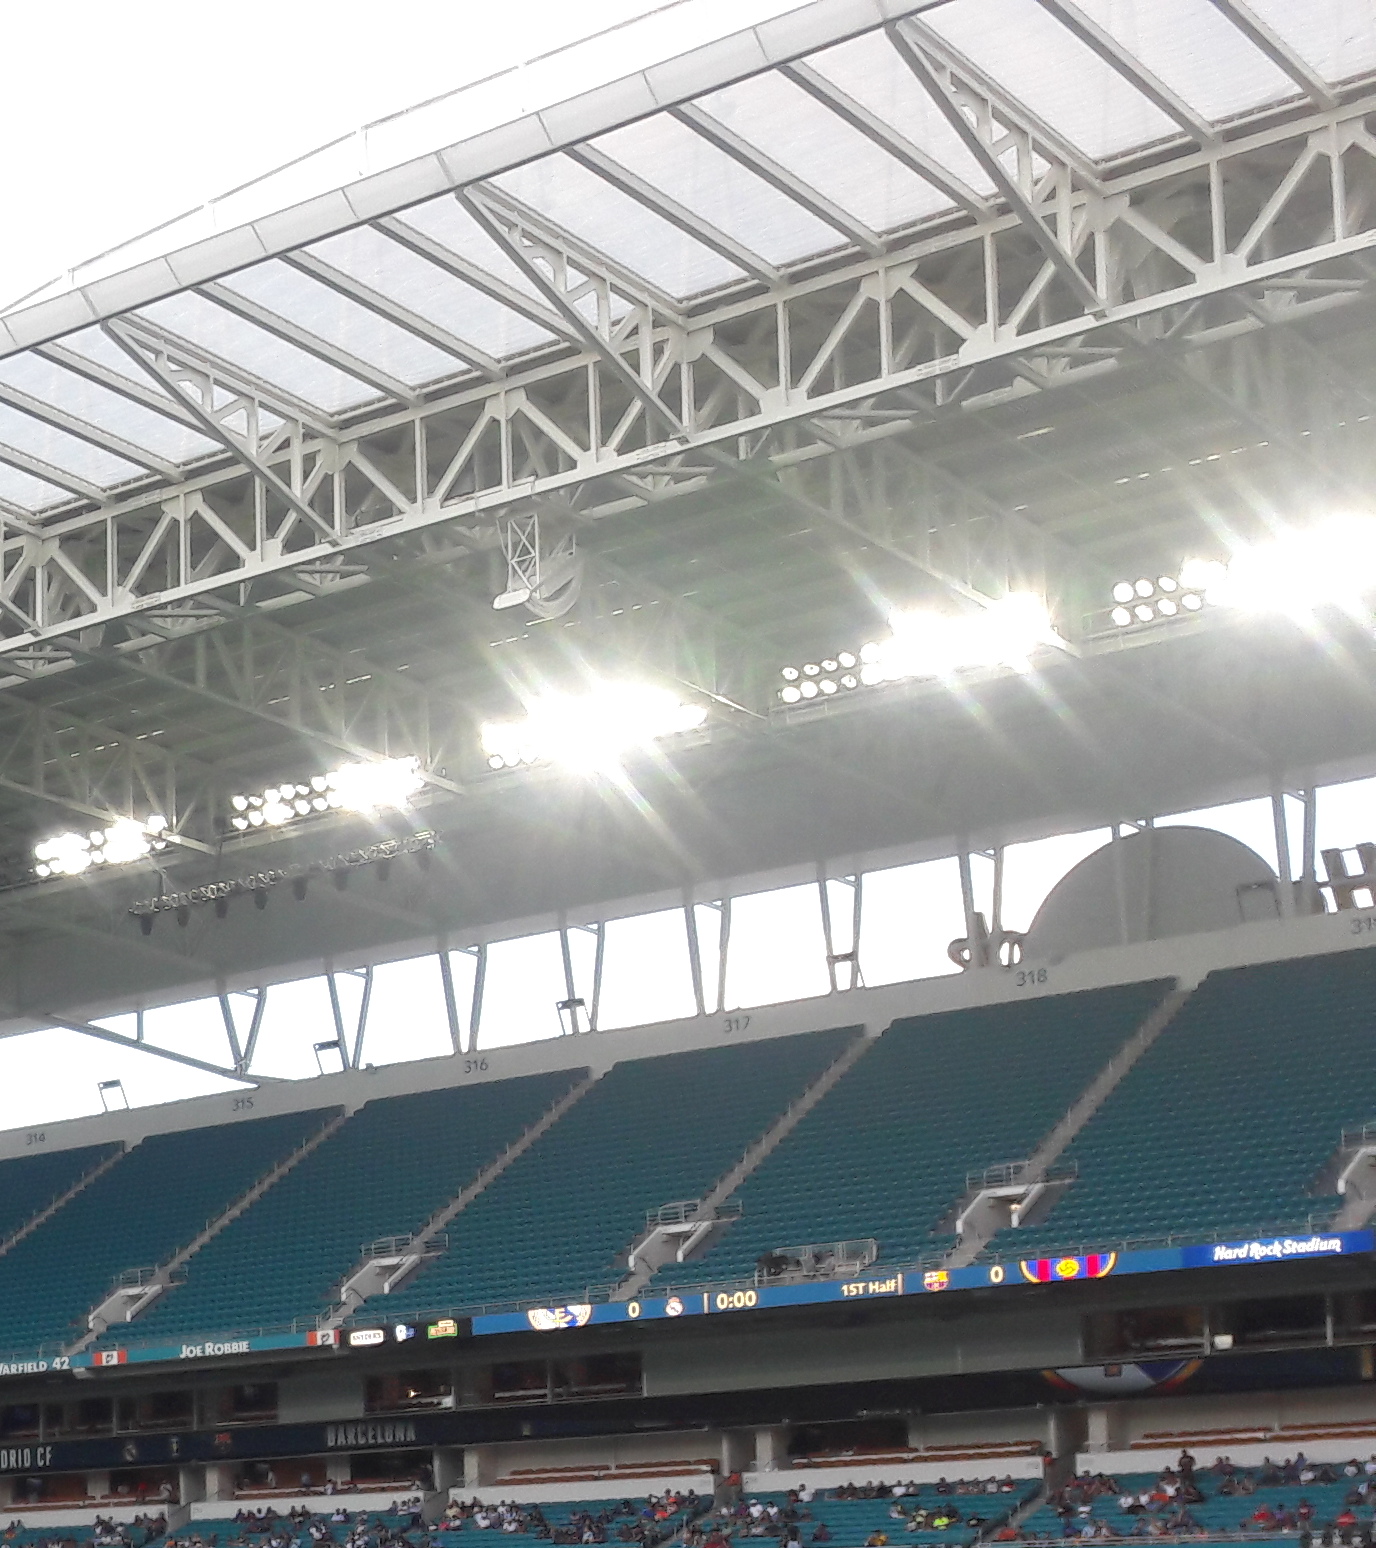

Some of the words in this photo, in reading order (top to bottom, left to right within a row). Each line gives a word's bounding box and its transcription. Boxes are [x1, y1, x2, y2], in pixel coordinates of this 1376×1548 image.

[1015, 969, 1048, 986] 318
[724, 1016, 752, 1033] 317
[464, 1057, 488, 1073] 316
[1214, 1243, 1248, 1261] Hard
[1249, 1242, 1282, 1259] Rock
[1283, 1237, 1342, 1255] Stadium
[990, 1266, 1004, 1283] 0
[841, 1283, 865, 1298] 1ST
[868, 1279, 898, 1296] Half
[716, 1291, 757, 1310] 0:00
[179, 1343, 203, 1359] JOE
[205, 1340, 250, 1356] ROBBIE
[52, 1356, 70, 1371] 42
[36, 1447, 52, 1467] CF
